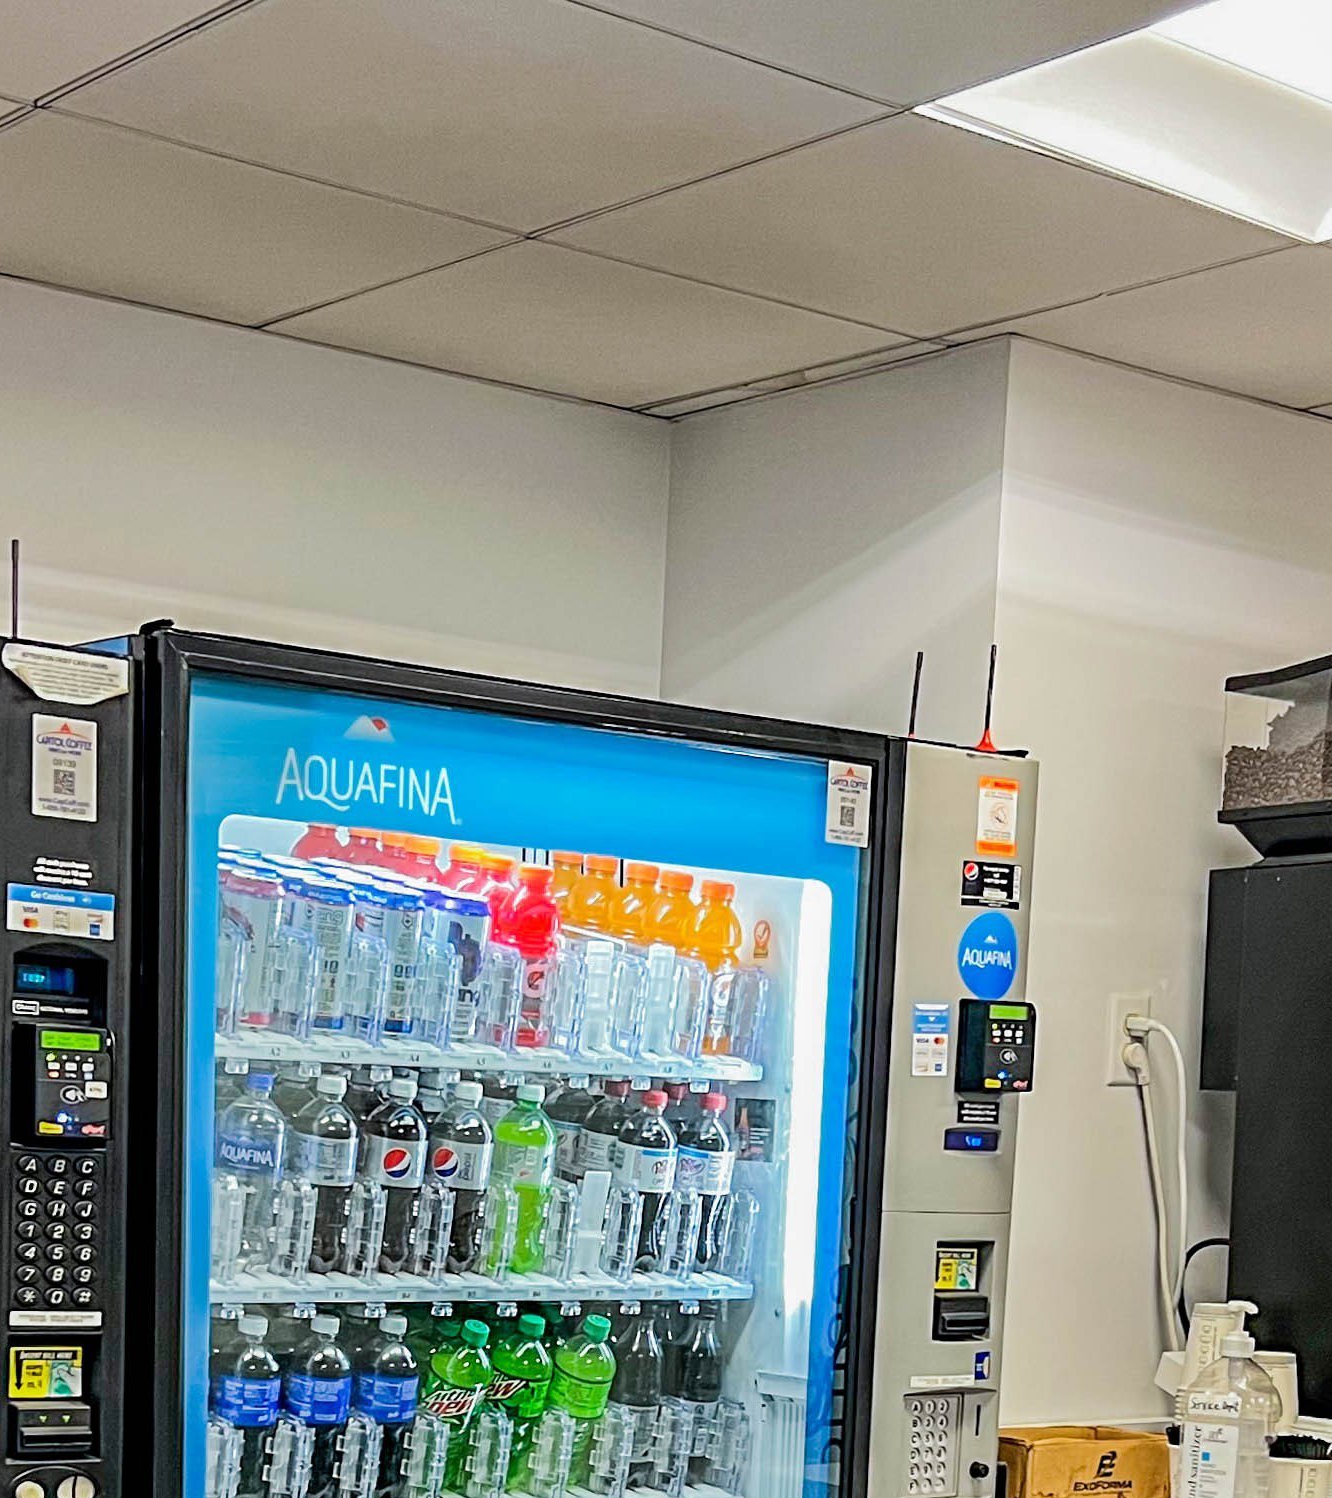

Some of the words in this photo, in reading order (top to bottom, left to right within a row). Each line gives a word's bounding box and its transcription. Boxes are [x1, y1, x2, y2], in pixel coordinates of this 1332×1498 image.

[276, 747, 457, 825] AQUAFINA
[962, 948, 1012, 970] AQUAFINA
[25, 1159, 37, 1171] A
[54, 1160, 66, 1172] B
[82, 1161, 94, 1174] C
[25, 1180, 37, 1193] D
[54, 1181, 65, 1194] E
[82, 1182, 93, 1196] F
[24, 1202, 37, 1216] G
[52, 1203, 66, 1216] H
[81, 1204, 92, 1217] J
[26, 1224, 35, 1237] 1
[52, 1225, 64, 1239] 2
[80, 1226, 92, 1240] 3
[24, 1246, 36, 1259] 4
[52, 1247, 64, 1260] 5
[80, 1248, 91, 1261] 6
[24, 1268, 35, 1281] 7
[52, 1268, 64, 1282] 8
[79, 1269, 91, 1282] 9
[51, 1290, 64, 1304] 0
[79, 1291, 91, 1303] #
[1189, 1425, 1203, 1476] sanitizer
[1073, 1480, 1132, 1492] EXOFORMA
